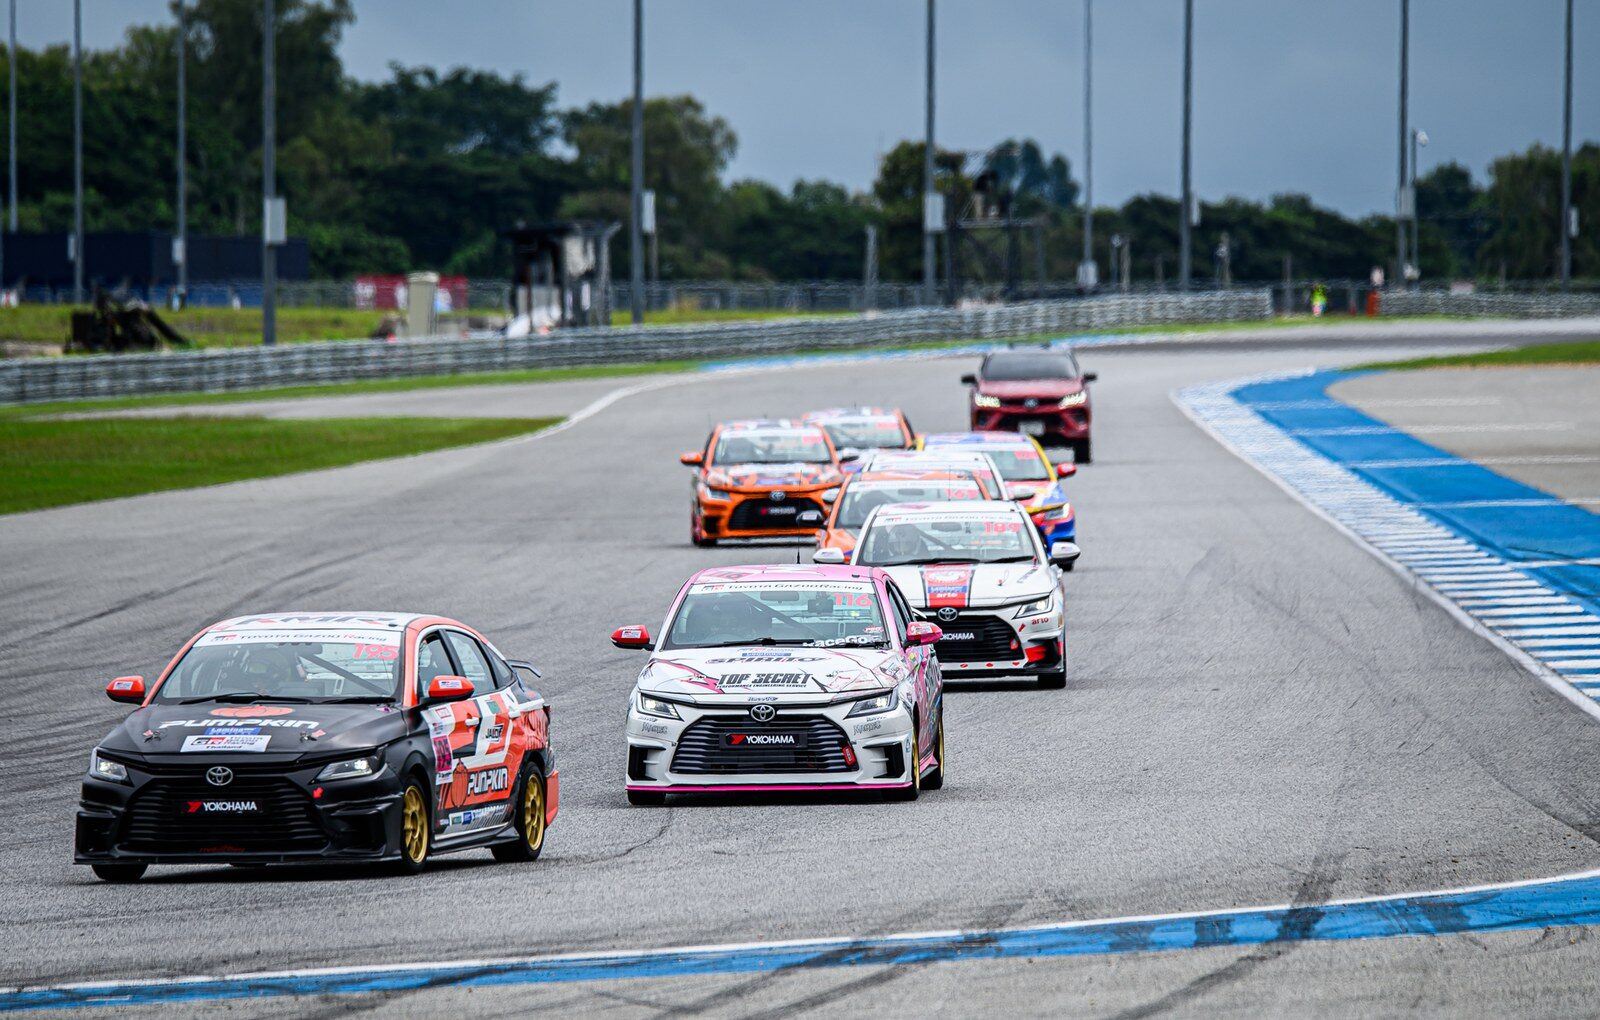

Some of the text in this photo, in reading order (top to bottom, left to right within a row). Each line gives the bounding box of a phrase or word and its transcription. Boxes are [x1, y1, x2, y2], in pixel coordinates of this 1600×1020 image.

[832, 592, 872, 608] 116
[940, 632, 975, 641] OKOHAMA
[352, 643, 399, 661] 195
[718, 673, 813, 685] TOP SECRET
[159, 718, 320, 729] PUMPKIN
[746, 735, 795, 744] YOKOHAMA
[203, 801, 258, 811] YOKOHAMA
